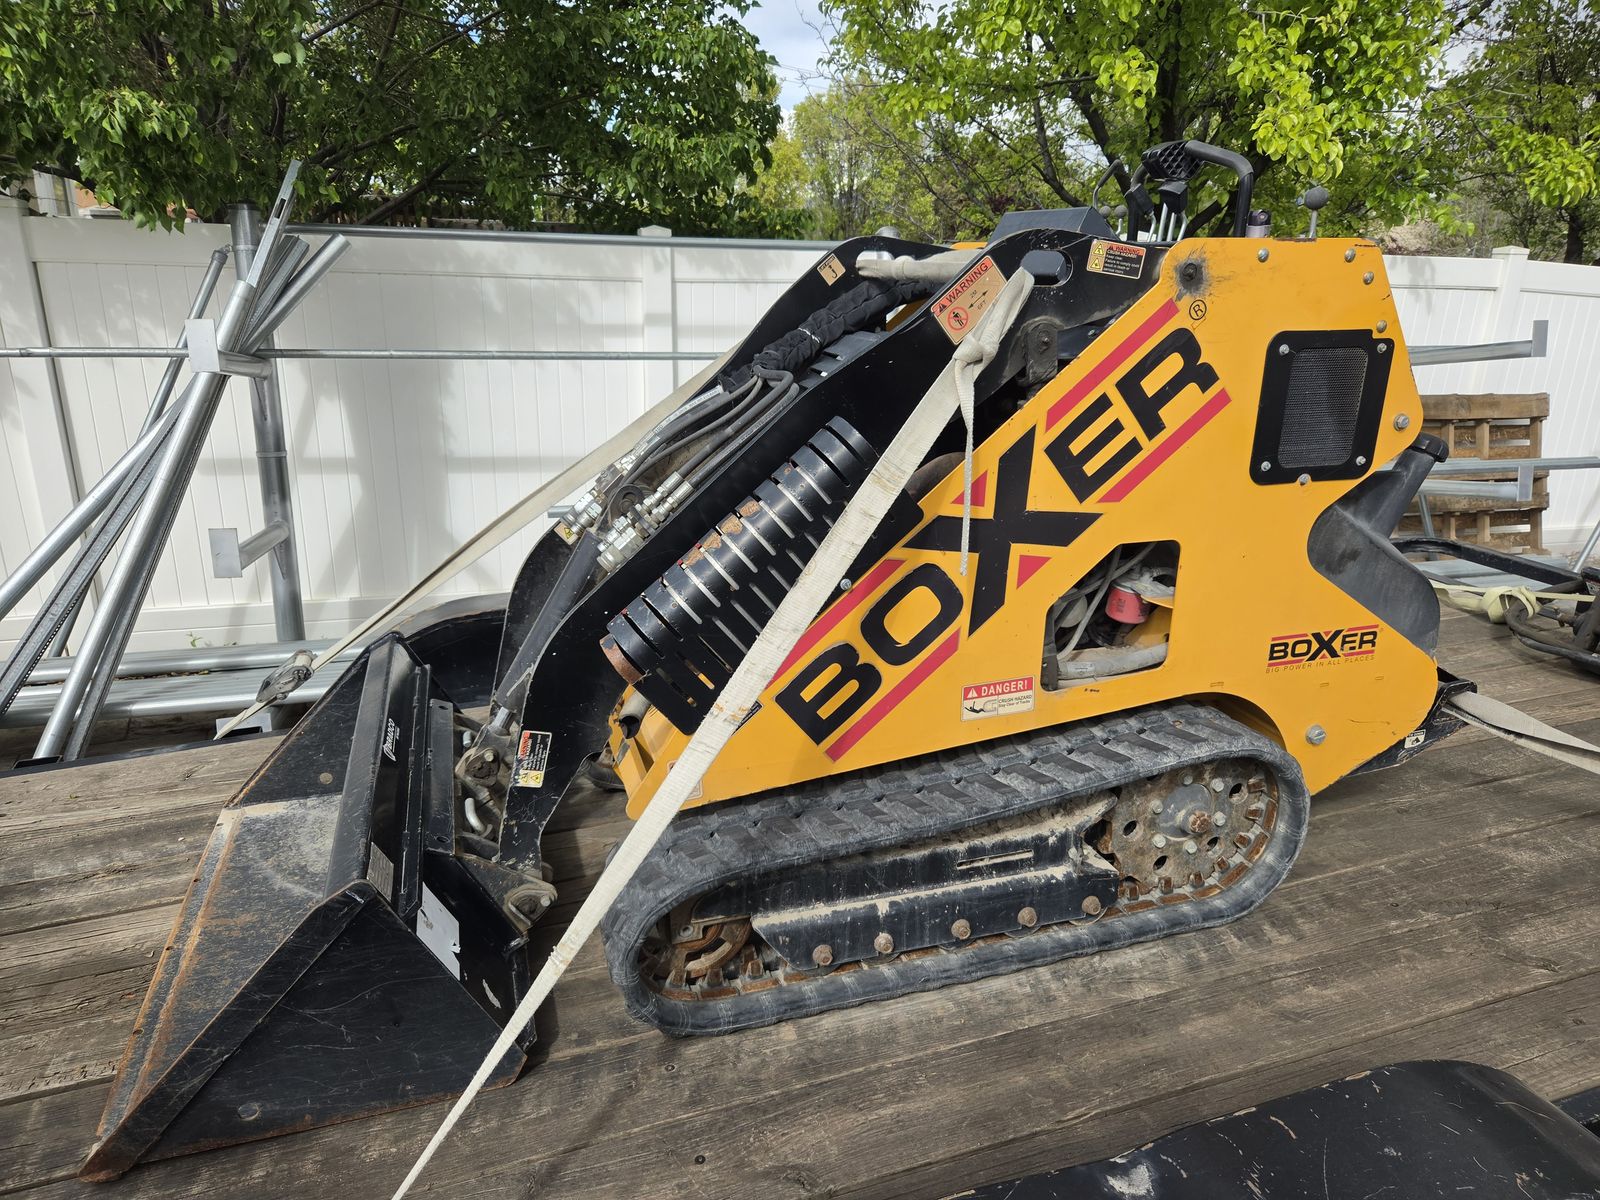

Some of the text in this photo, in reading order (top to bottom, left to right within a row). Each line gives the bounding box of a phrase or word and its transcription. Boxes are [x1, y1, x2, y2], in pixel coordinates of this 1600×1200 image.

[946, 262, 988, 303] WARNING
[775, 328, 1219, 746] BOXER
[1268, 629, 1378, 662] BOXER
[1265, 666, 1280, 674] BIG
[1283, 662, 1312, 671] POWER
[1345, 655, 1375, 664] PLACES
[981, 679, 1028, 696] DANGER!
